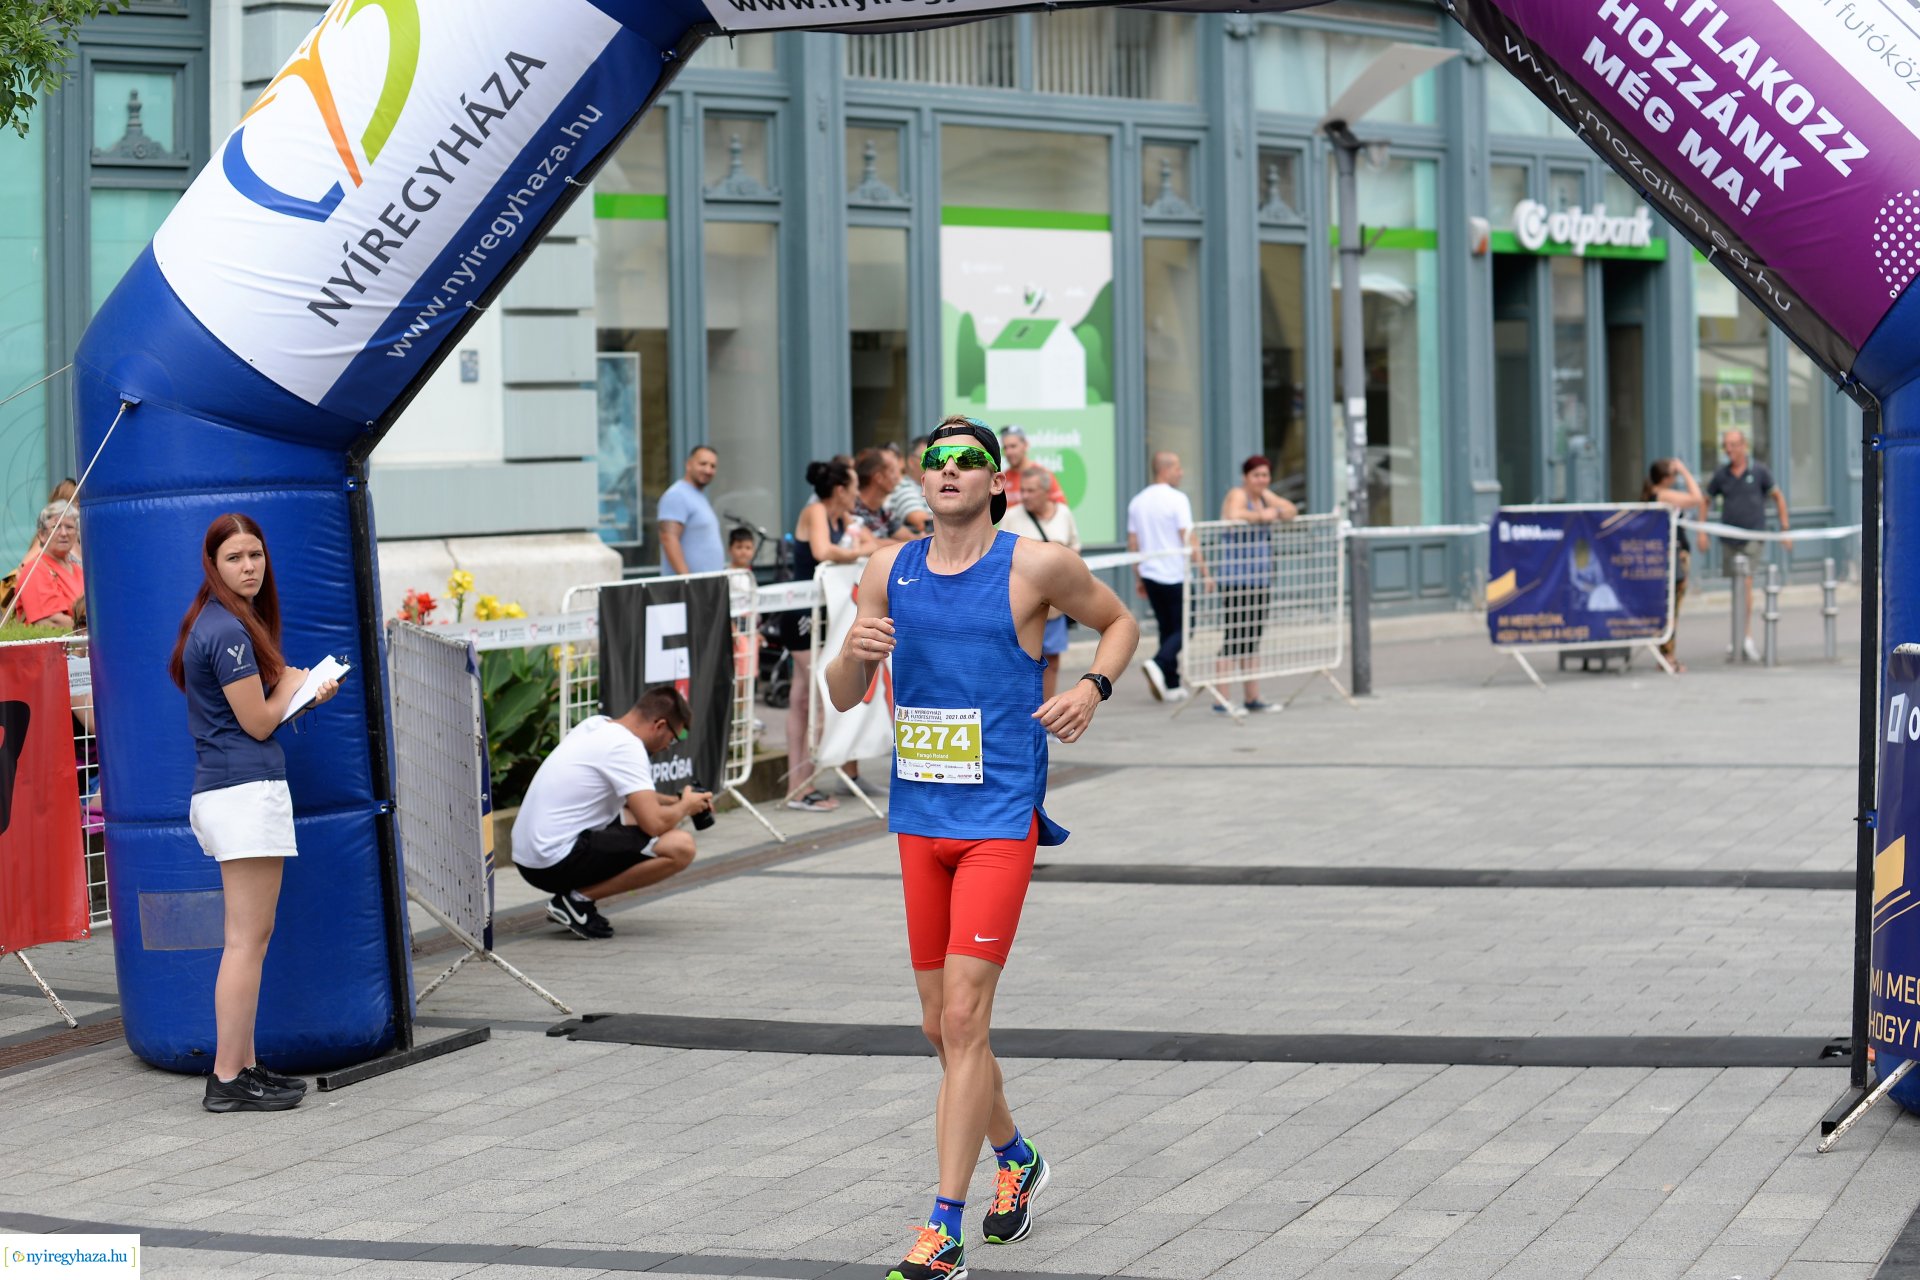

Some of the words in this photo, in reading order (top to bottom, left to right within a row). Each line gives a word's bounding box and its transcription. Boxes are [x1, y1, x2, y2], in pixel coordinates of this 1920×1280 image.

[1582, 36, 1675, 133] MÉG
[1677, 127, 1761, 216] MA!
[1597, 0, 1802, 192] HOZZÁNK
[1664, 0, 1870, 178] TLAKOZZ
[307, 50, 547, 327] NYÍREGYHÁZA
[387, 104, 604, 358] www.nyiregyhaza.hu
[1549, 203, 1653, 257] otpbank
[900, 724, 970, 750] 2274
[1868, 1009, 1911, 1046] HOGY
